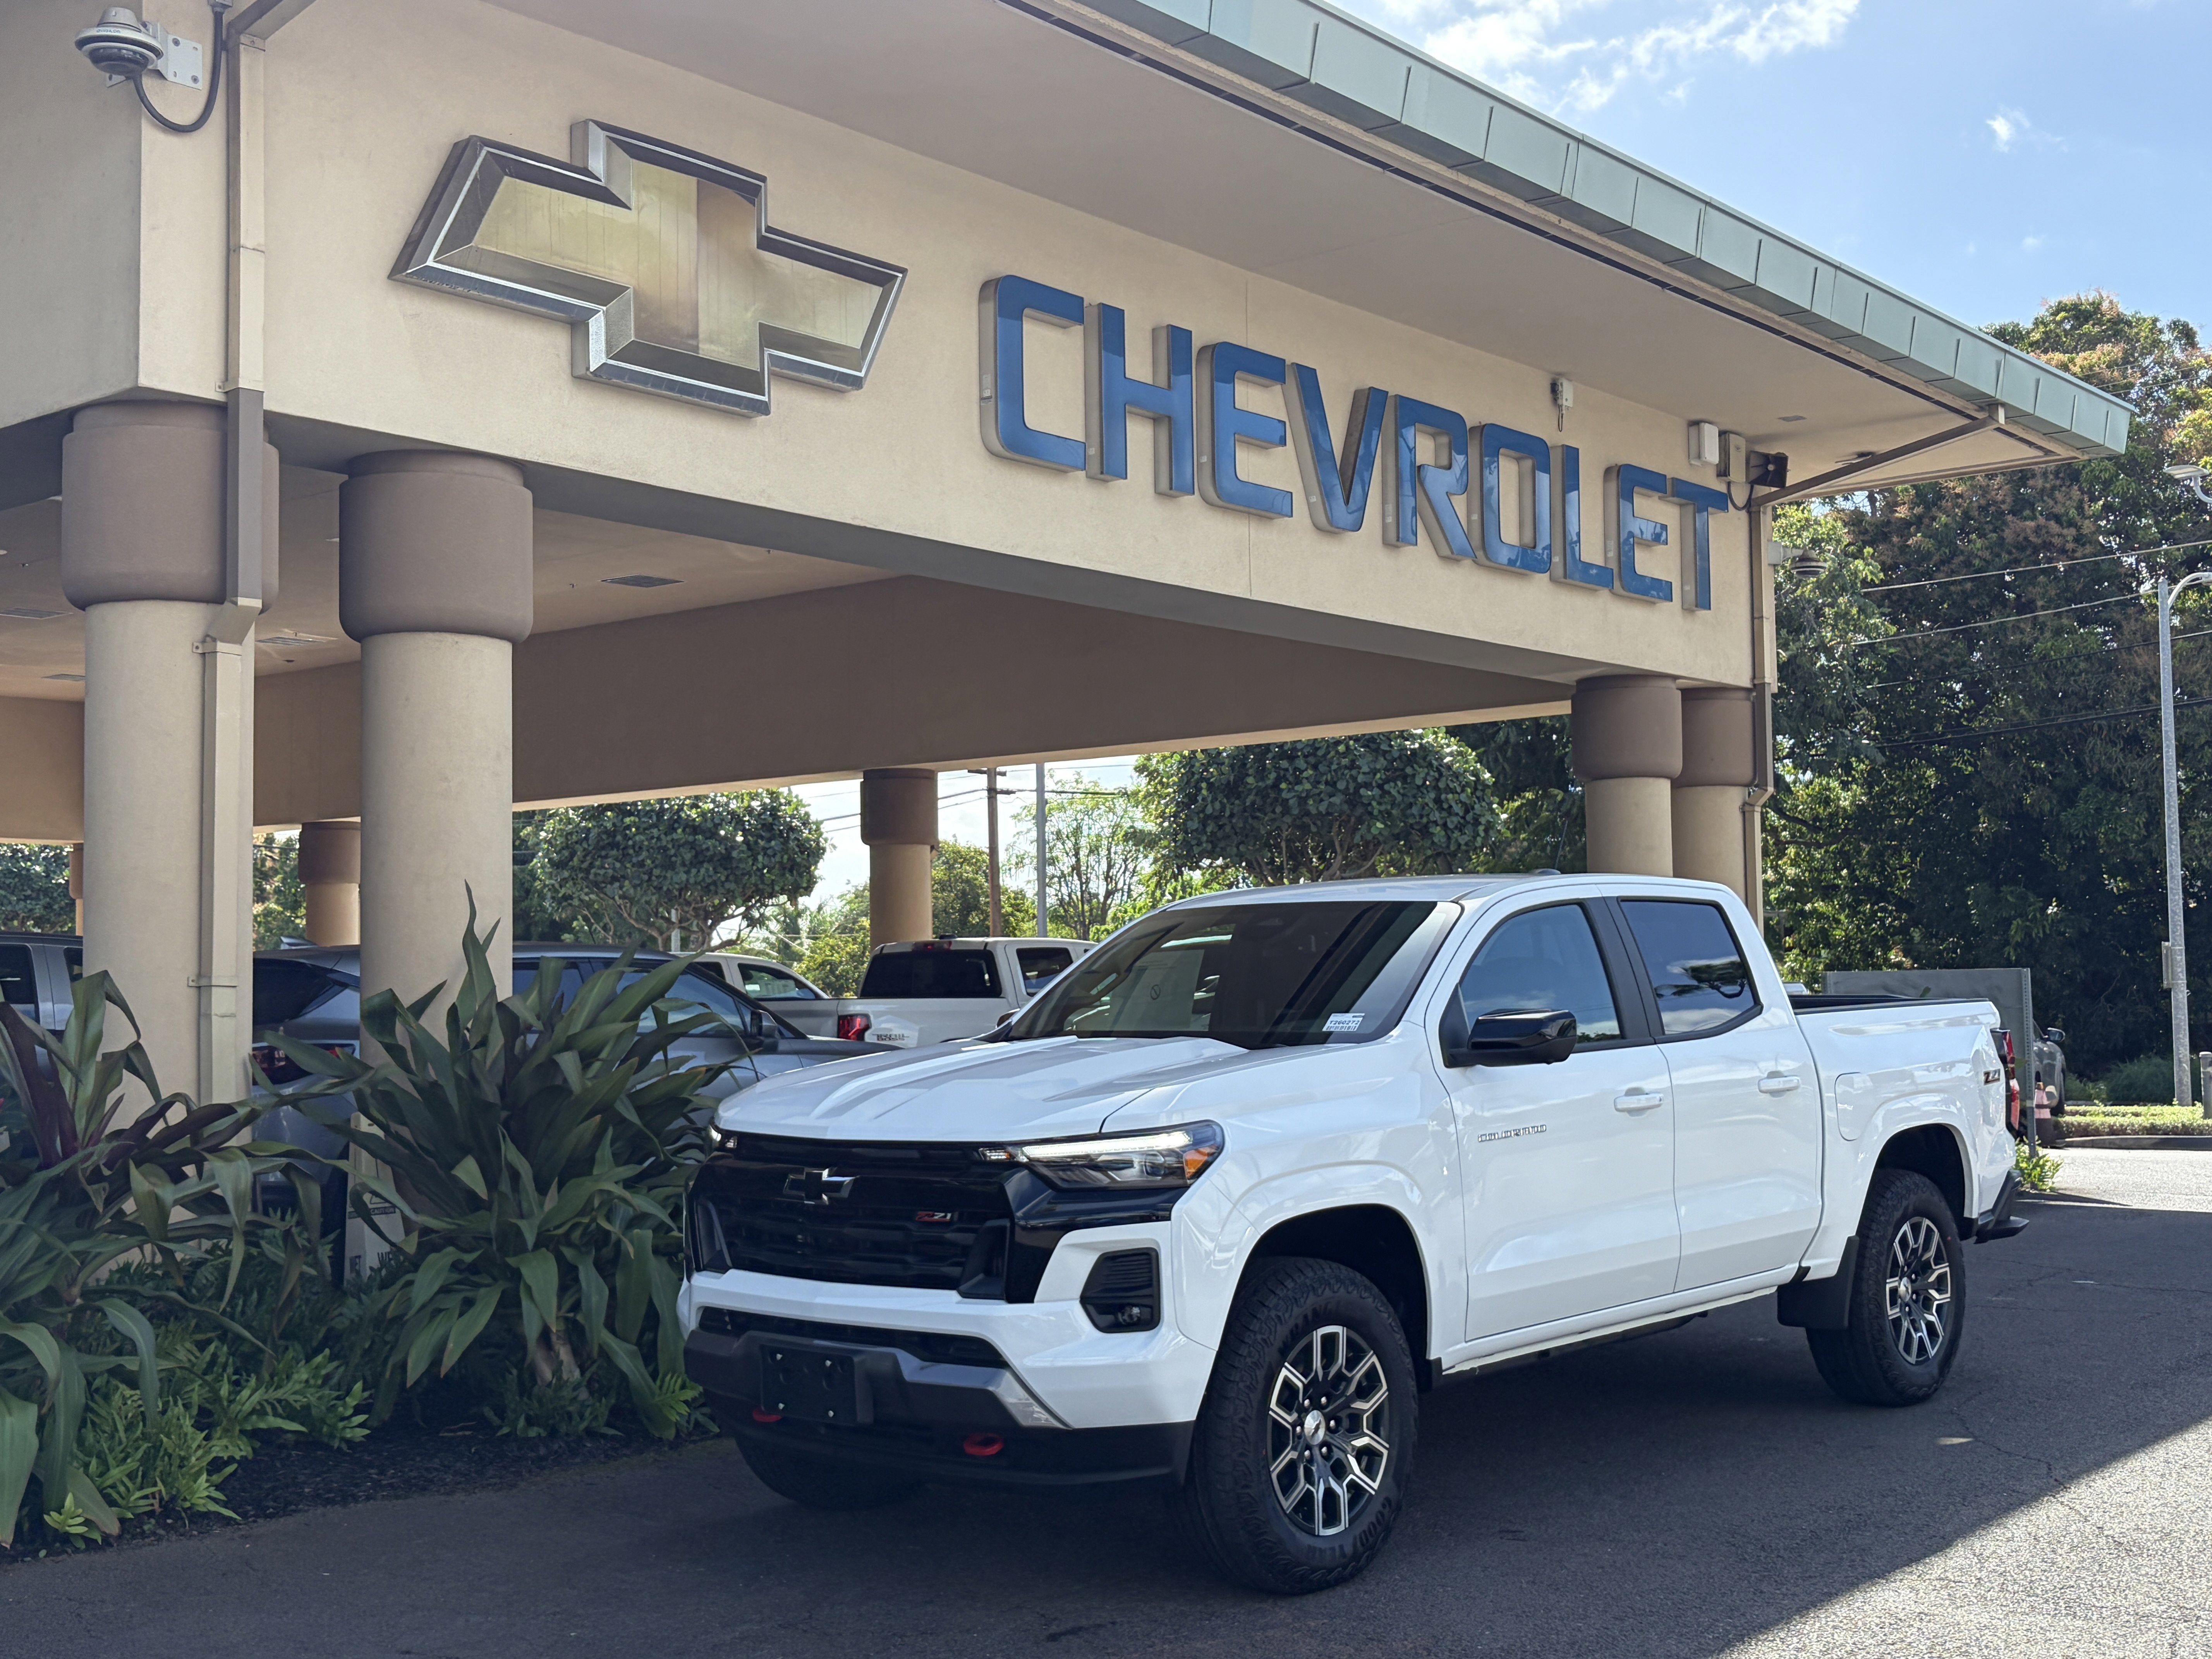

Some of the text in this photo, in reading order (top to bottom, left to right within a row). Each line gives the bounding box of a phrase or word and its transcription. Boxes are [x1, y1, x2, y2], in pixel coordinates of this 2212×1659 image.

[980, 275, 1729, 611] CHEVROLET
[1983, 1068, 2001, 1085] Z71
[1478, 1125, 1547, 1143] COLORADO
[915, 1211, 952, 1222] Z71
